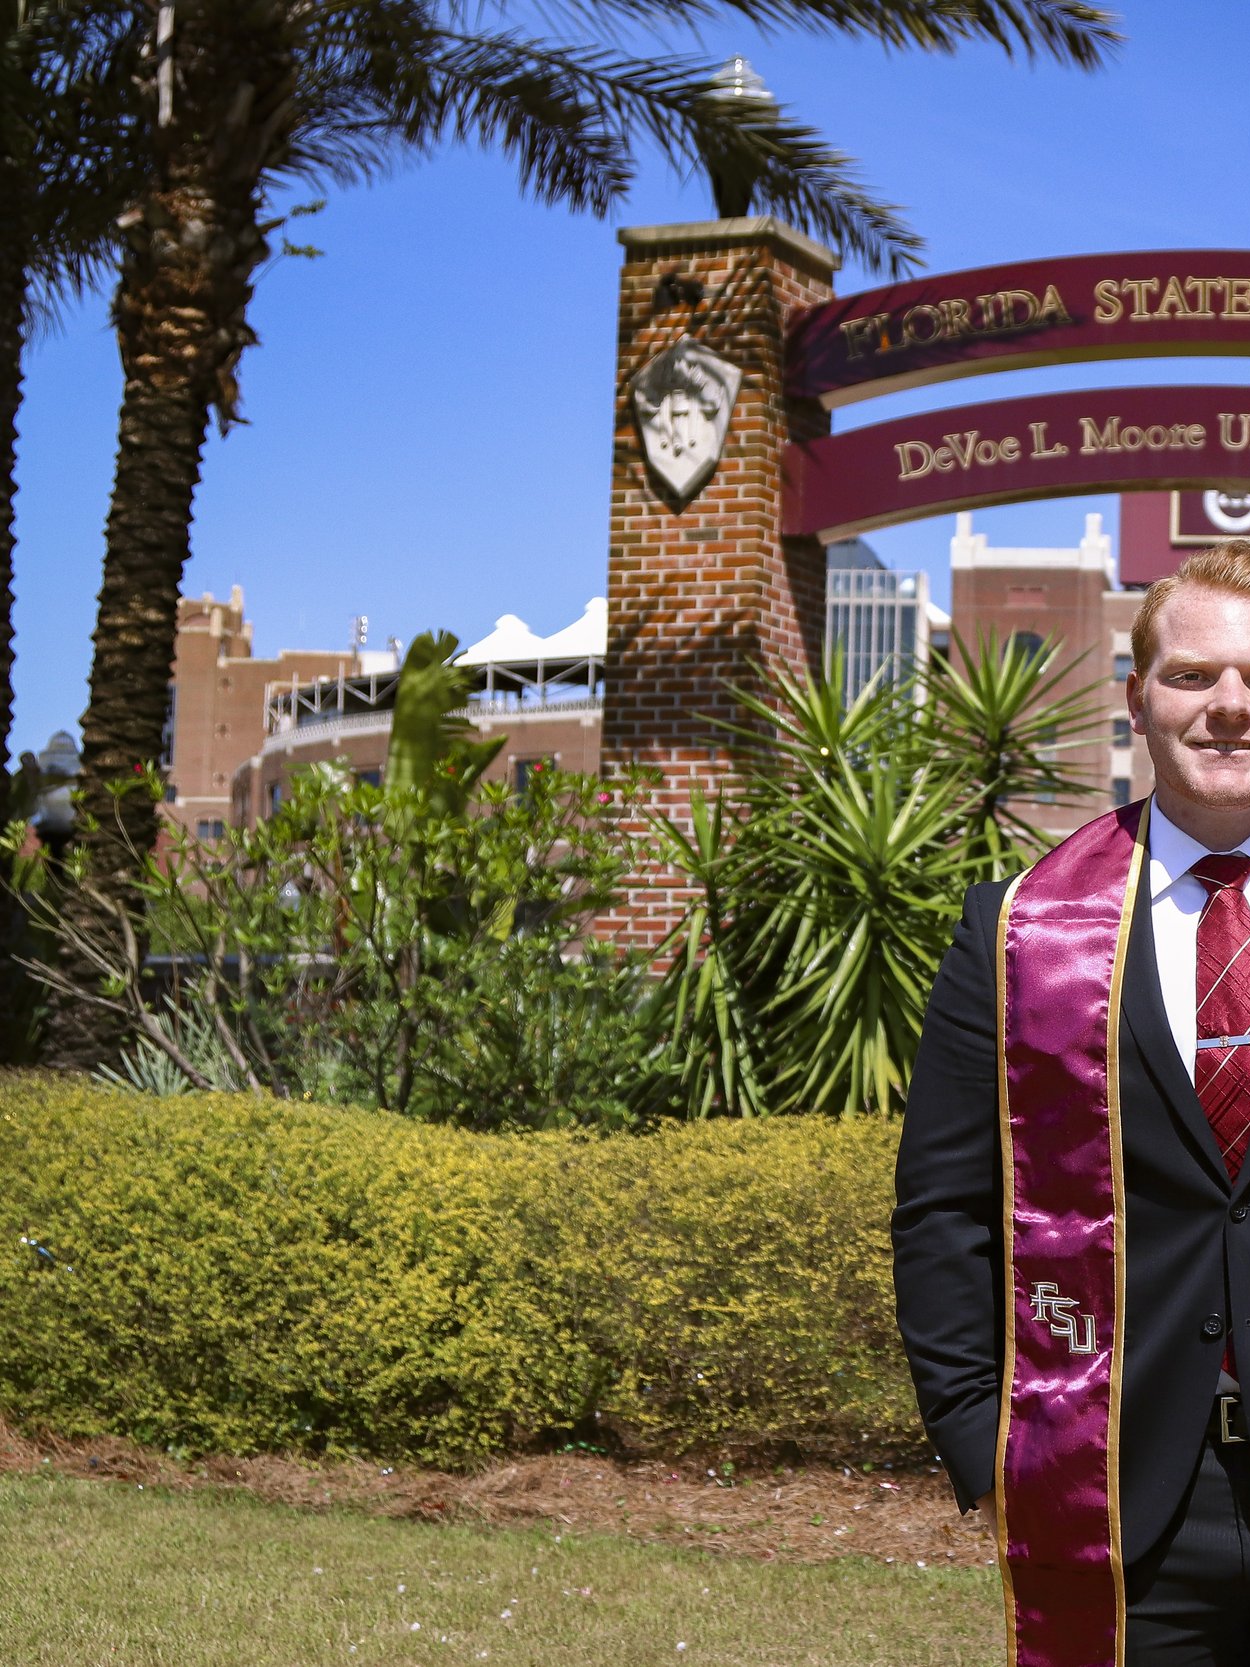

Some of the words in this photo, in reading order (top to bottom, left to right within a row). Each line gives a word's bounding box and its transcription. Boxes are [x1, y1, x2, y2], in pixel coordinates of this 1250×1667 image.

[839, 284, 1073, 361] FLORIDA
[894, 430, 1021, 481] DeVoe
[1028, 421, 1069, 458] L.
[1079, 415, 1206, 455] Moore
[1029, 1281, 1099, 1355] FSU
